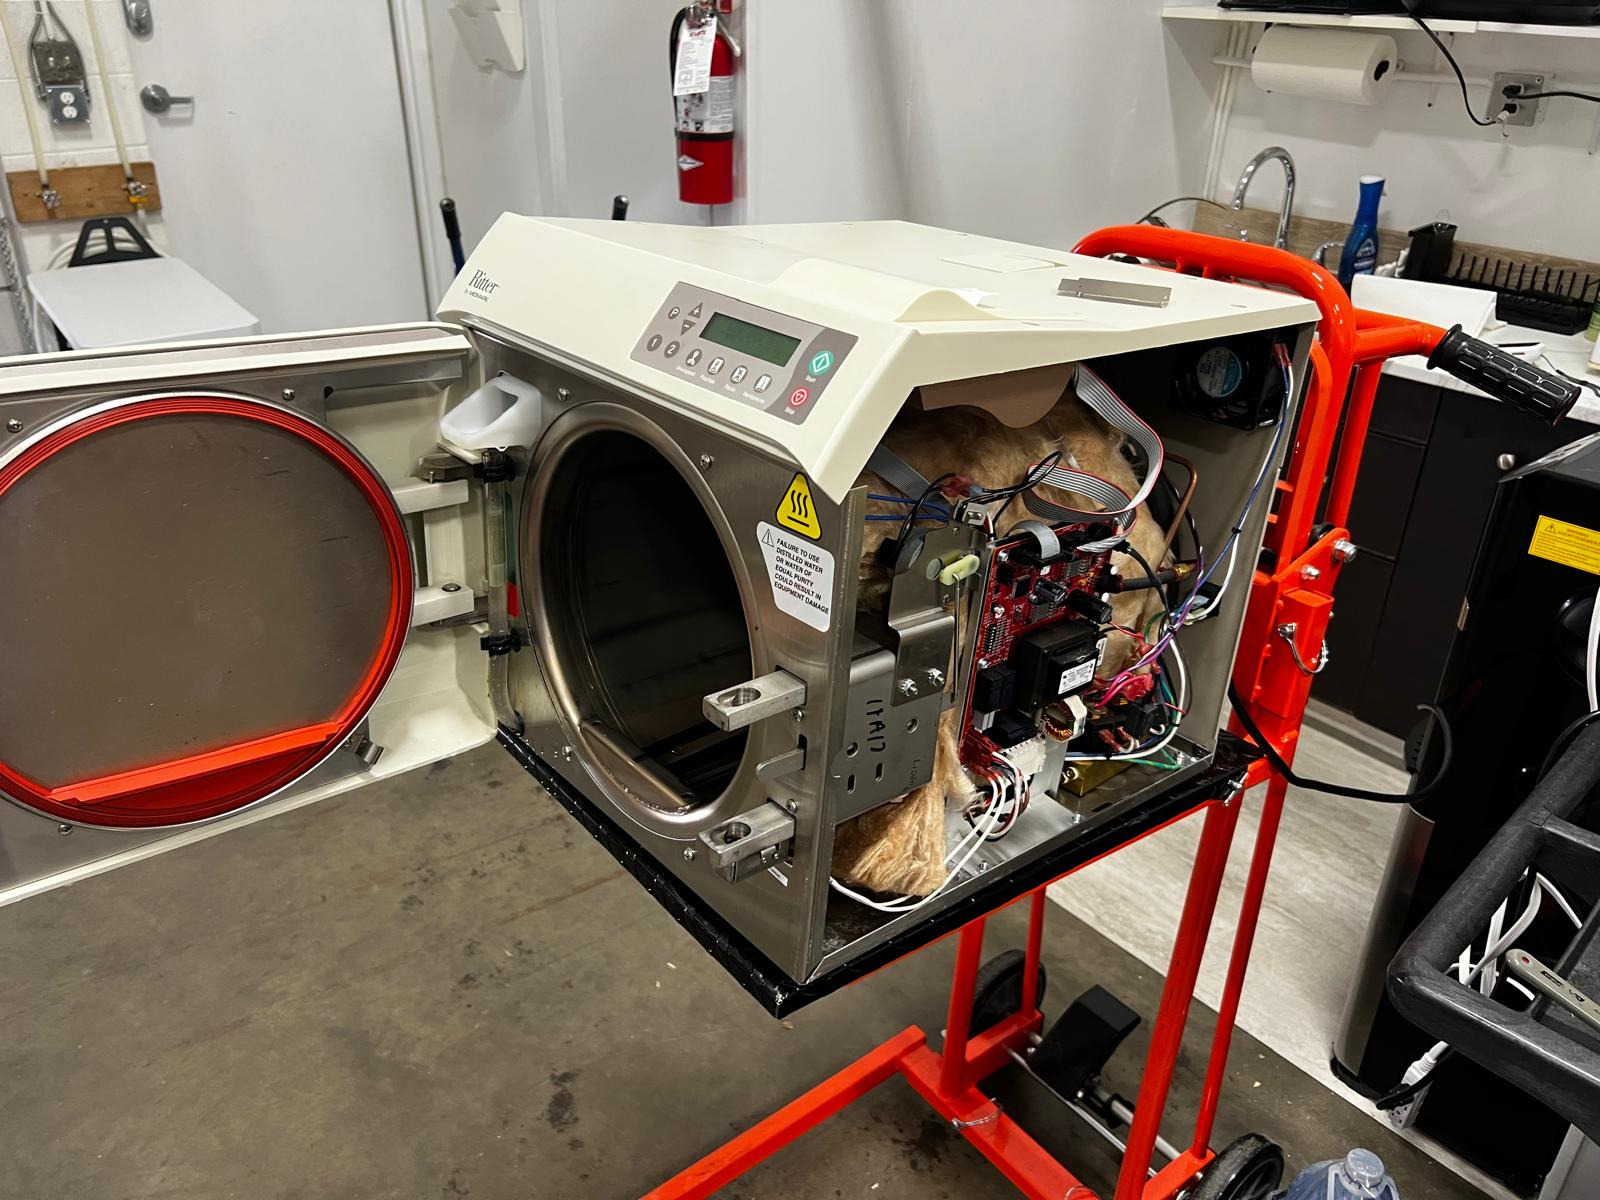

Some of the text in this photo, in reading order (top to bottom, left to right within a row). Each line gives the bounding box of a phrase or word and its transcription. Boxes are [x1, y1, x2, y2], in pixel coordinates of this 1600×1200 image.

[469, 270, 499, 294] Ritter
[776, 538, 820, 564] FAILURE TO USE
[776, 547, 824, 574] DISTILLED WATER
[775, 565, 814, 587] EQUAL PURITY
[776, 556, 812, 576] OR WATER OF
[774, 573, 822, 601] COULD RESULT IN
[774, 582, 830, 615] EQUIPMENT DAMAGE
